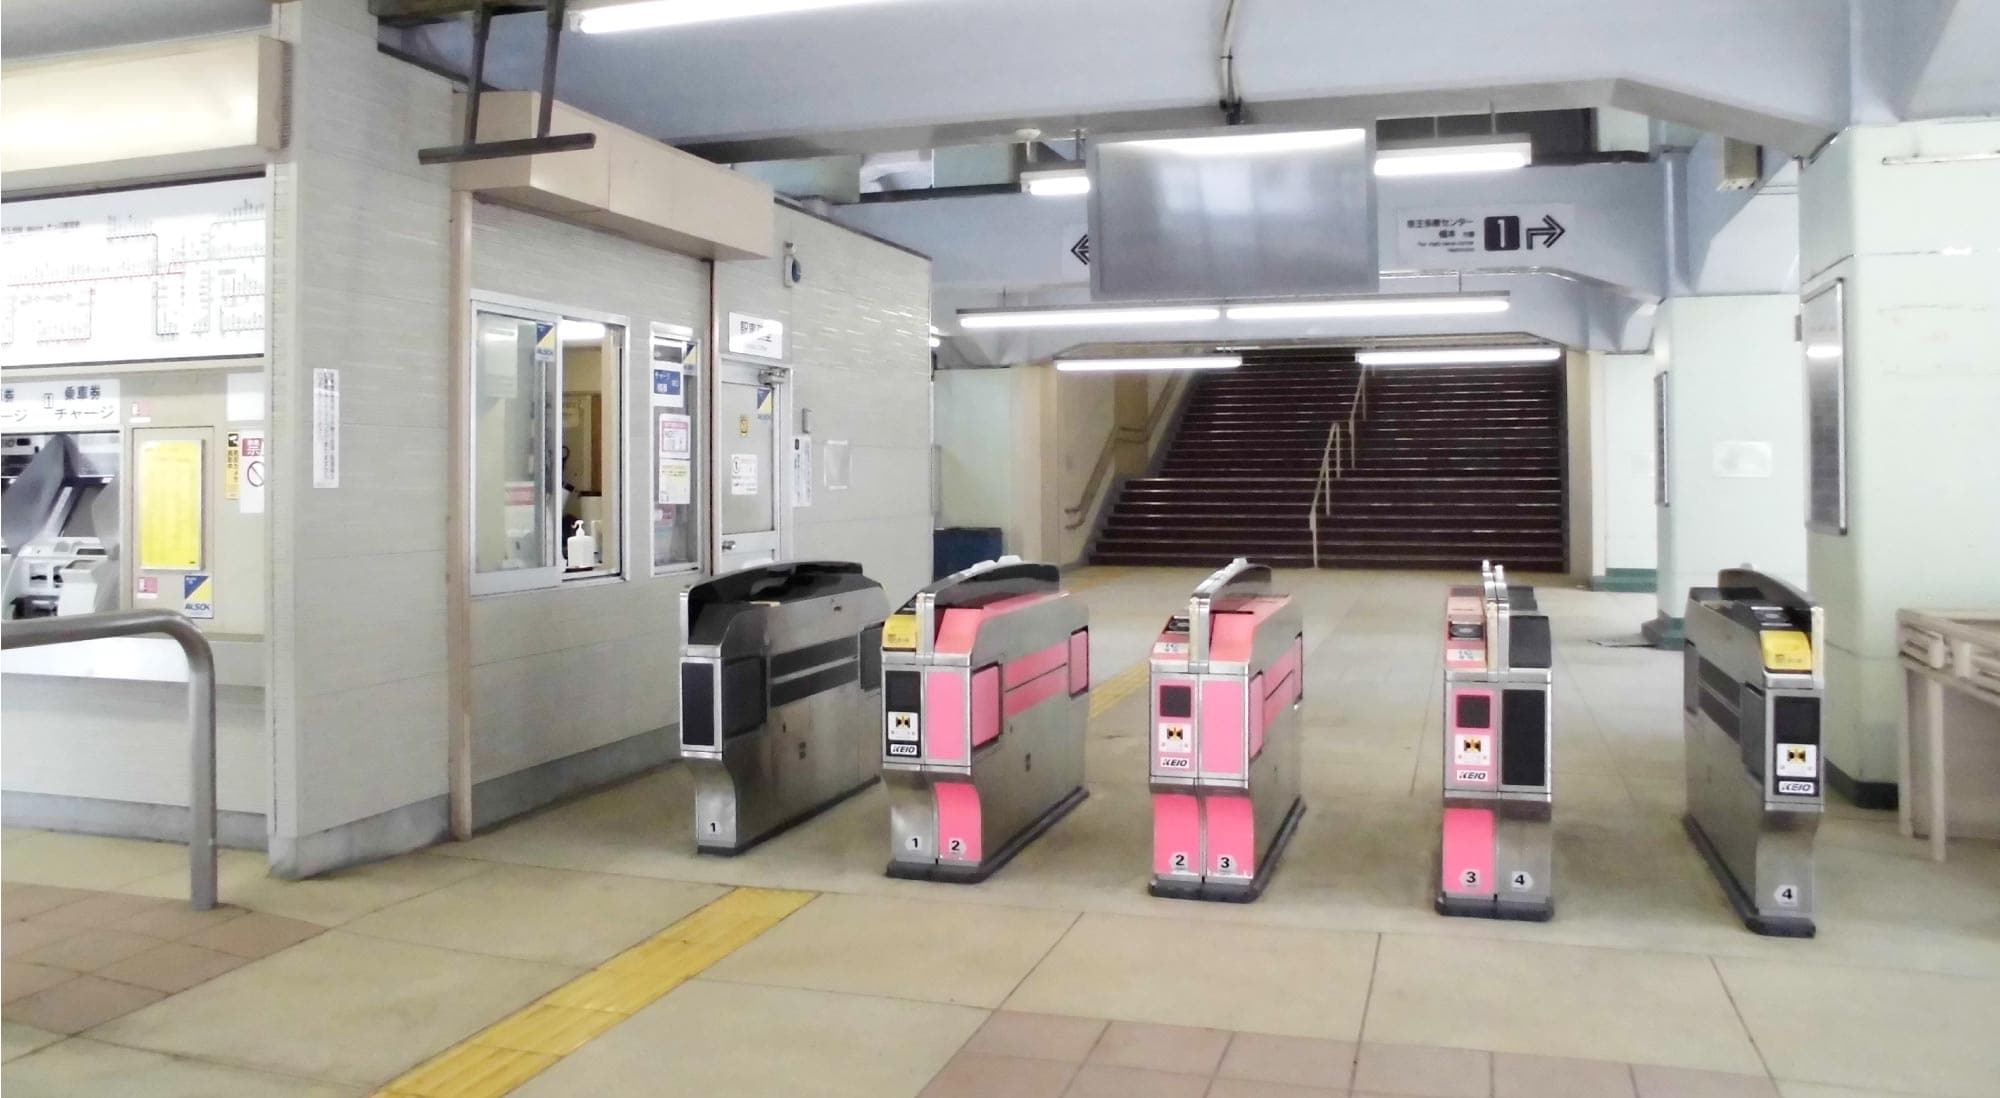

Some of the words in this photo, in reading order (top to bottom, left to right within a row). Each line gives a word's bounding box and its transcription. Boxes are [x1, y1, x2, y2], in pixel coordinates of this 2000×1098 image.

[1497, 218, 1506, 248] 1
[54, 405, 114, 421] チャージ
[892, 745, 916, 754] KEIO
[1162, 758, 1188, 767] KEIO
[1459, 771, 1486, 780] KEIO
[1781, 782, 1811, 792] KEIO
[710, 822, 716, 833] 1
[911, 837, 918, 849] 1
[951, 839, 960, 851] 2
[1175, 854, 1185, 866] 2
[1220, 857, 1230, 868] 3
[1466, 871, 1476, 883] 3
[1514, 874, 1525, 885] 4
[1782, 888, 1793, 900] 4
